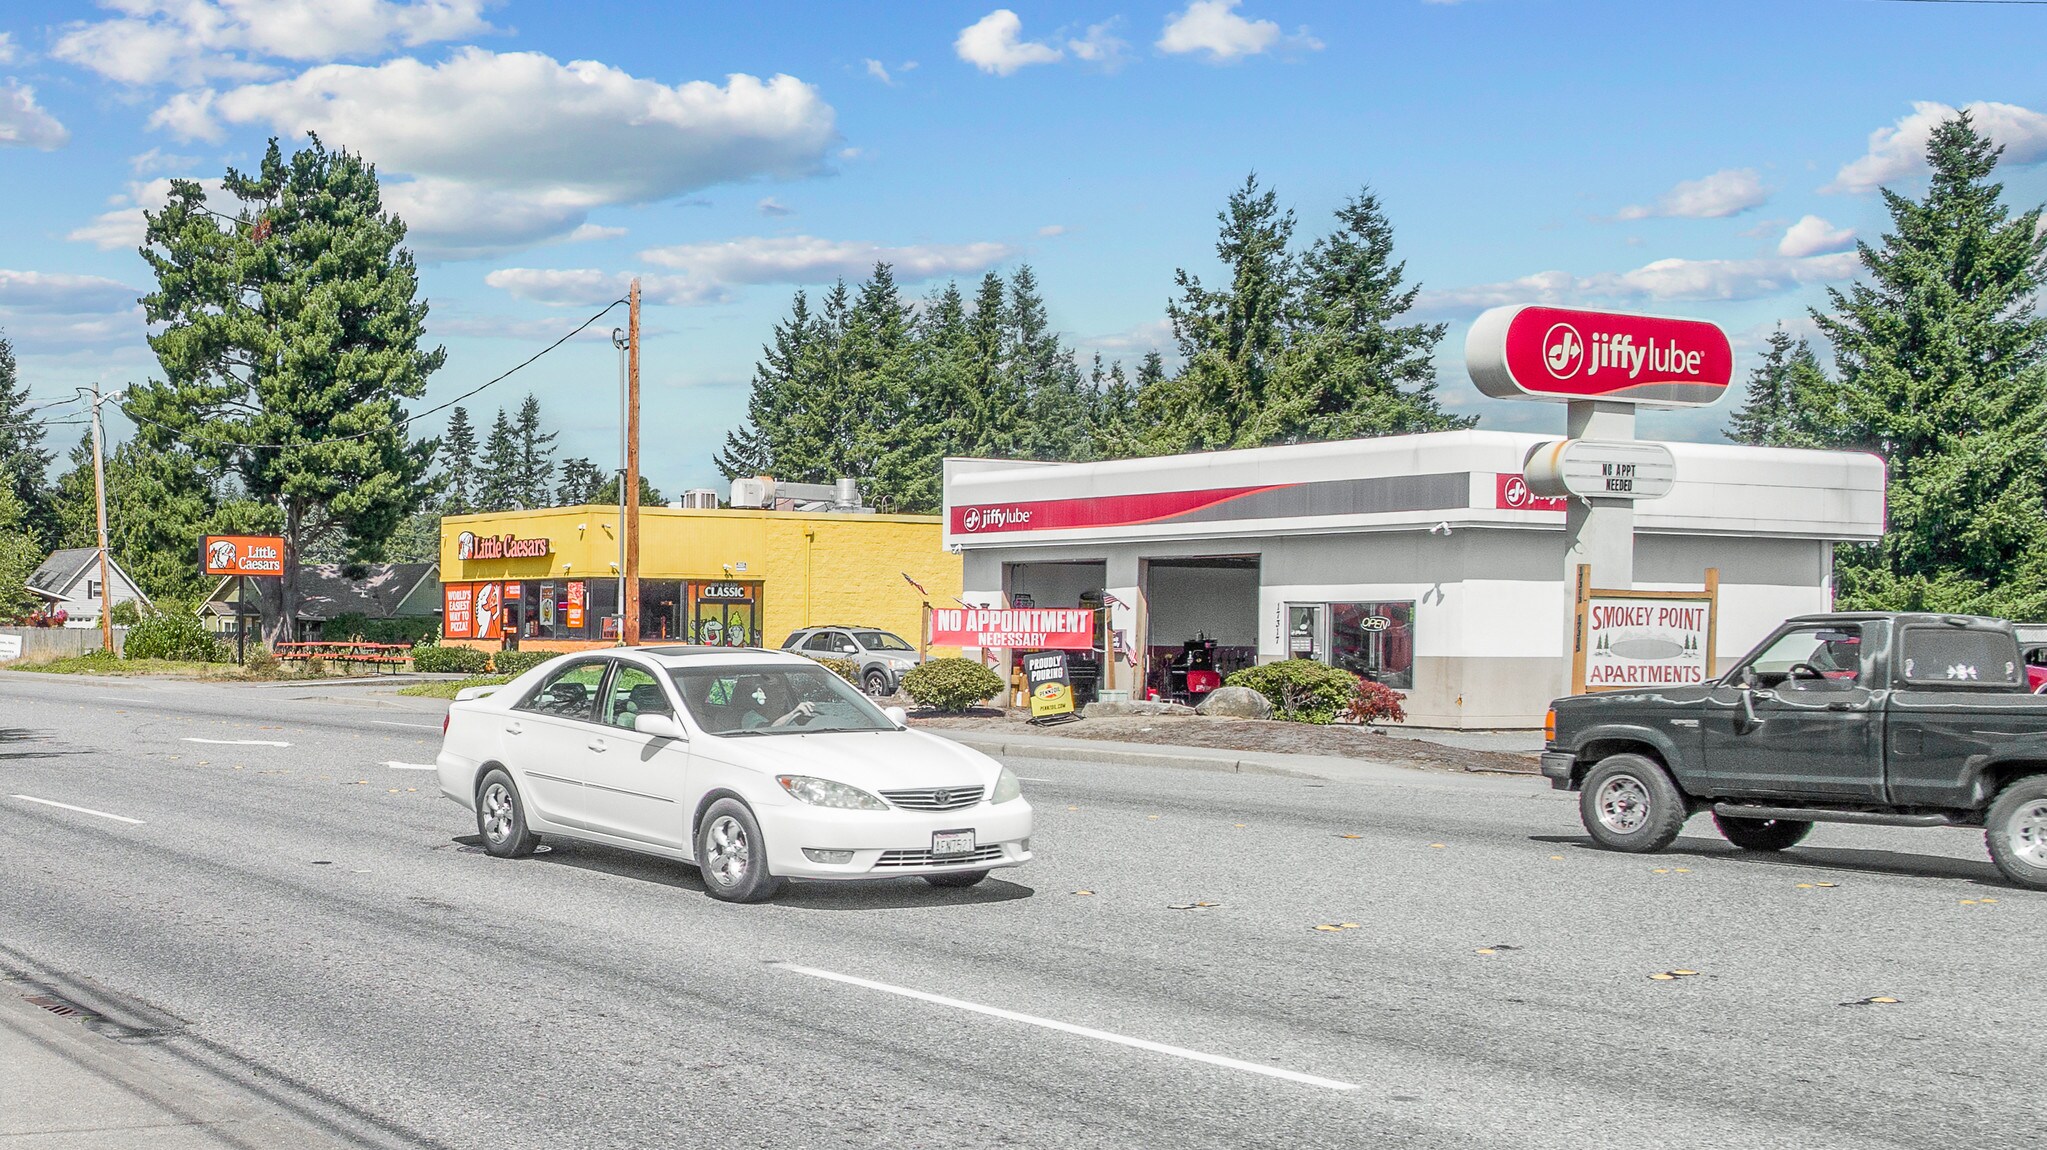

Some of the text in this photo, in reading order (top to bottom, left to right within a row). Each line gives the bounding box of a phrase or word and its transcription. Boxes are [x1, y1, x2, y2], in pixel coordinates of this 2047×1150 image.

[1615, 463, 1635, 477] APPT
[1605, 478, 1632, 491] NEEDED
[248, 545, 276, 559] Little
[473, 534, 547, 559] Little Caesars
[238, 557, 280, 570] Caesars
[447, 590, 471, 600] WORLD'S
[704, 586, 744, 597] CLASSIC
[448, 601, 470, 611] EASIEST
[449, 611, 469, 621] WAY TO
[937, 609, 1089, 633] NO APPOINTMENT
[1592, 605, 1705, 632] SMOKEY POINT
[450, 621, 468, 632] PIZZA!
[1361, 617, 1389, 630] OPEN
[978, 632, 1047, 646] NECESSARY
[1029, 655, 1062, 671] PROUDLY
[1031, 667, 1064, 682] POURING
[1590, 665, 1701, 683] APARTMENTS
